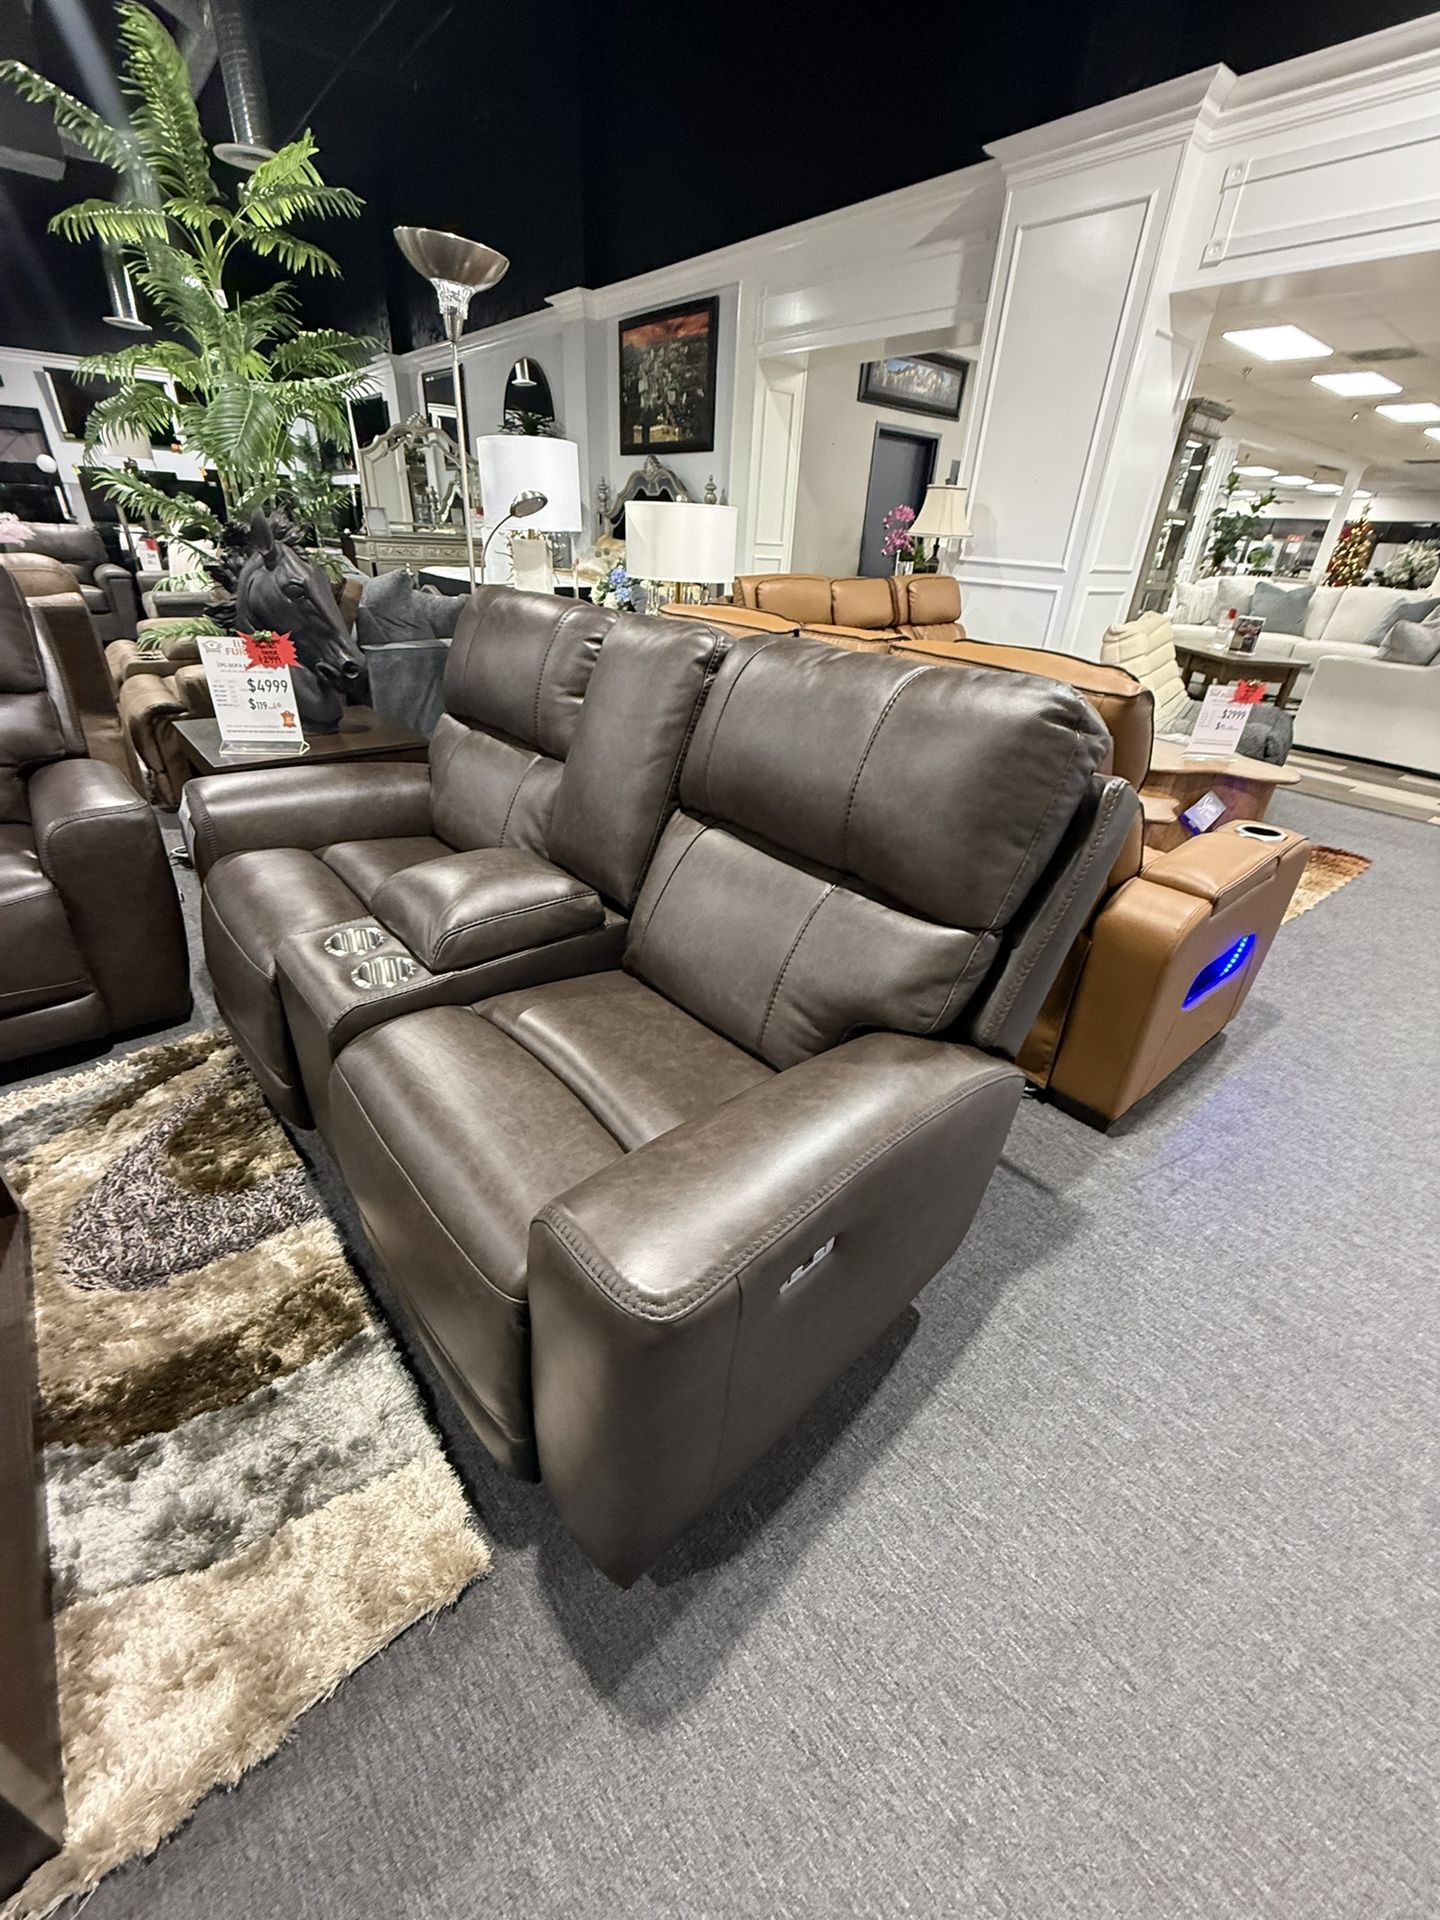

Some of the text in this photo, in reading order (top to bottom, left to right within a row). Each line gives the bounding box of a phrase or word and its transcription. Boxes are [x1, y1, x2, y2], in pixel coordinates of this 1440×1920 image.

[247, 678, 288, 693] $4999
[248, 698, 268, 711] $119
[1221, 709, 1247, 719] $2999
